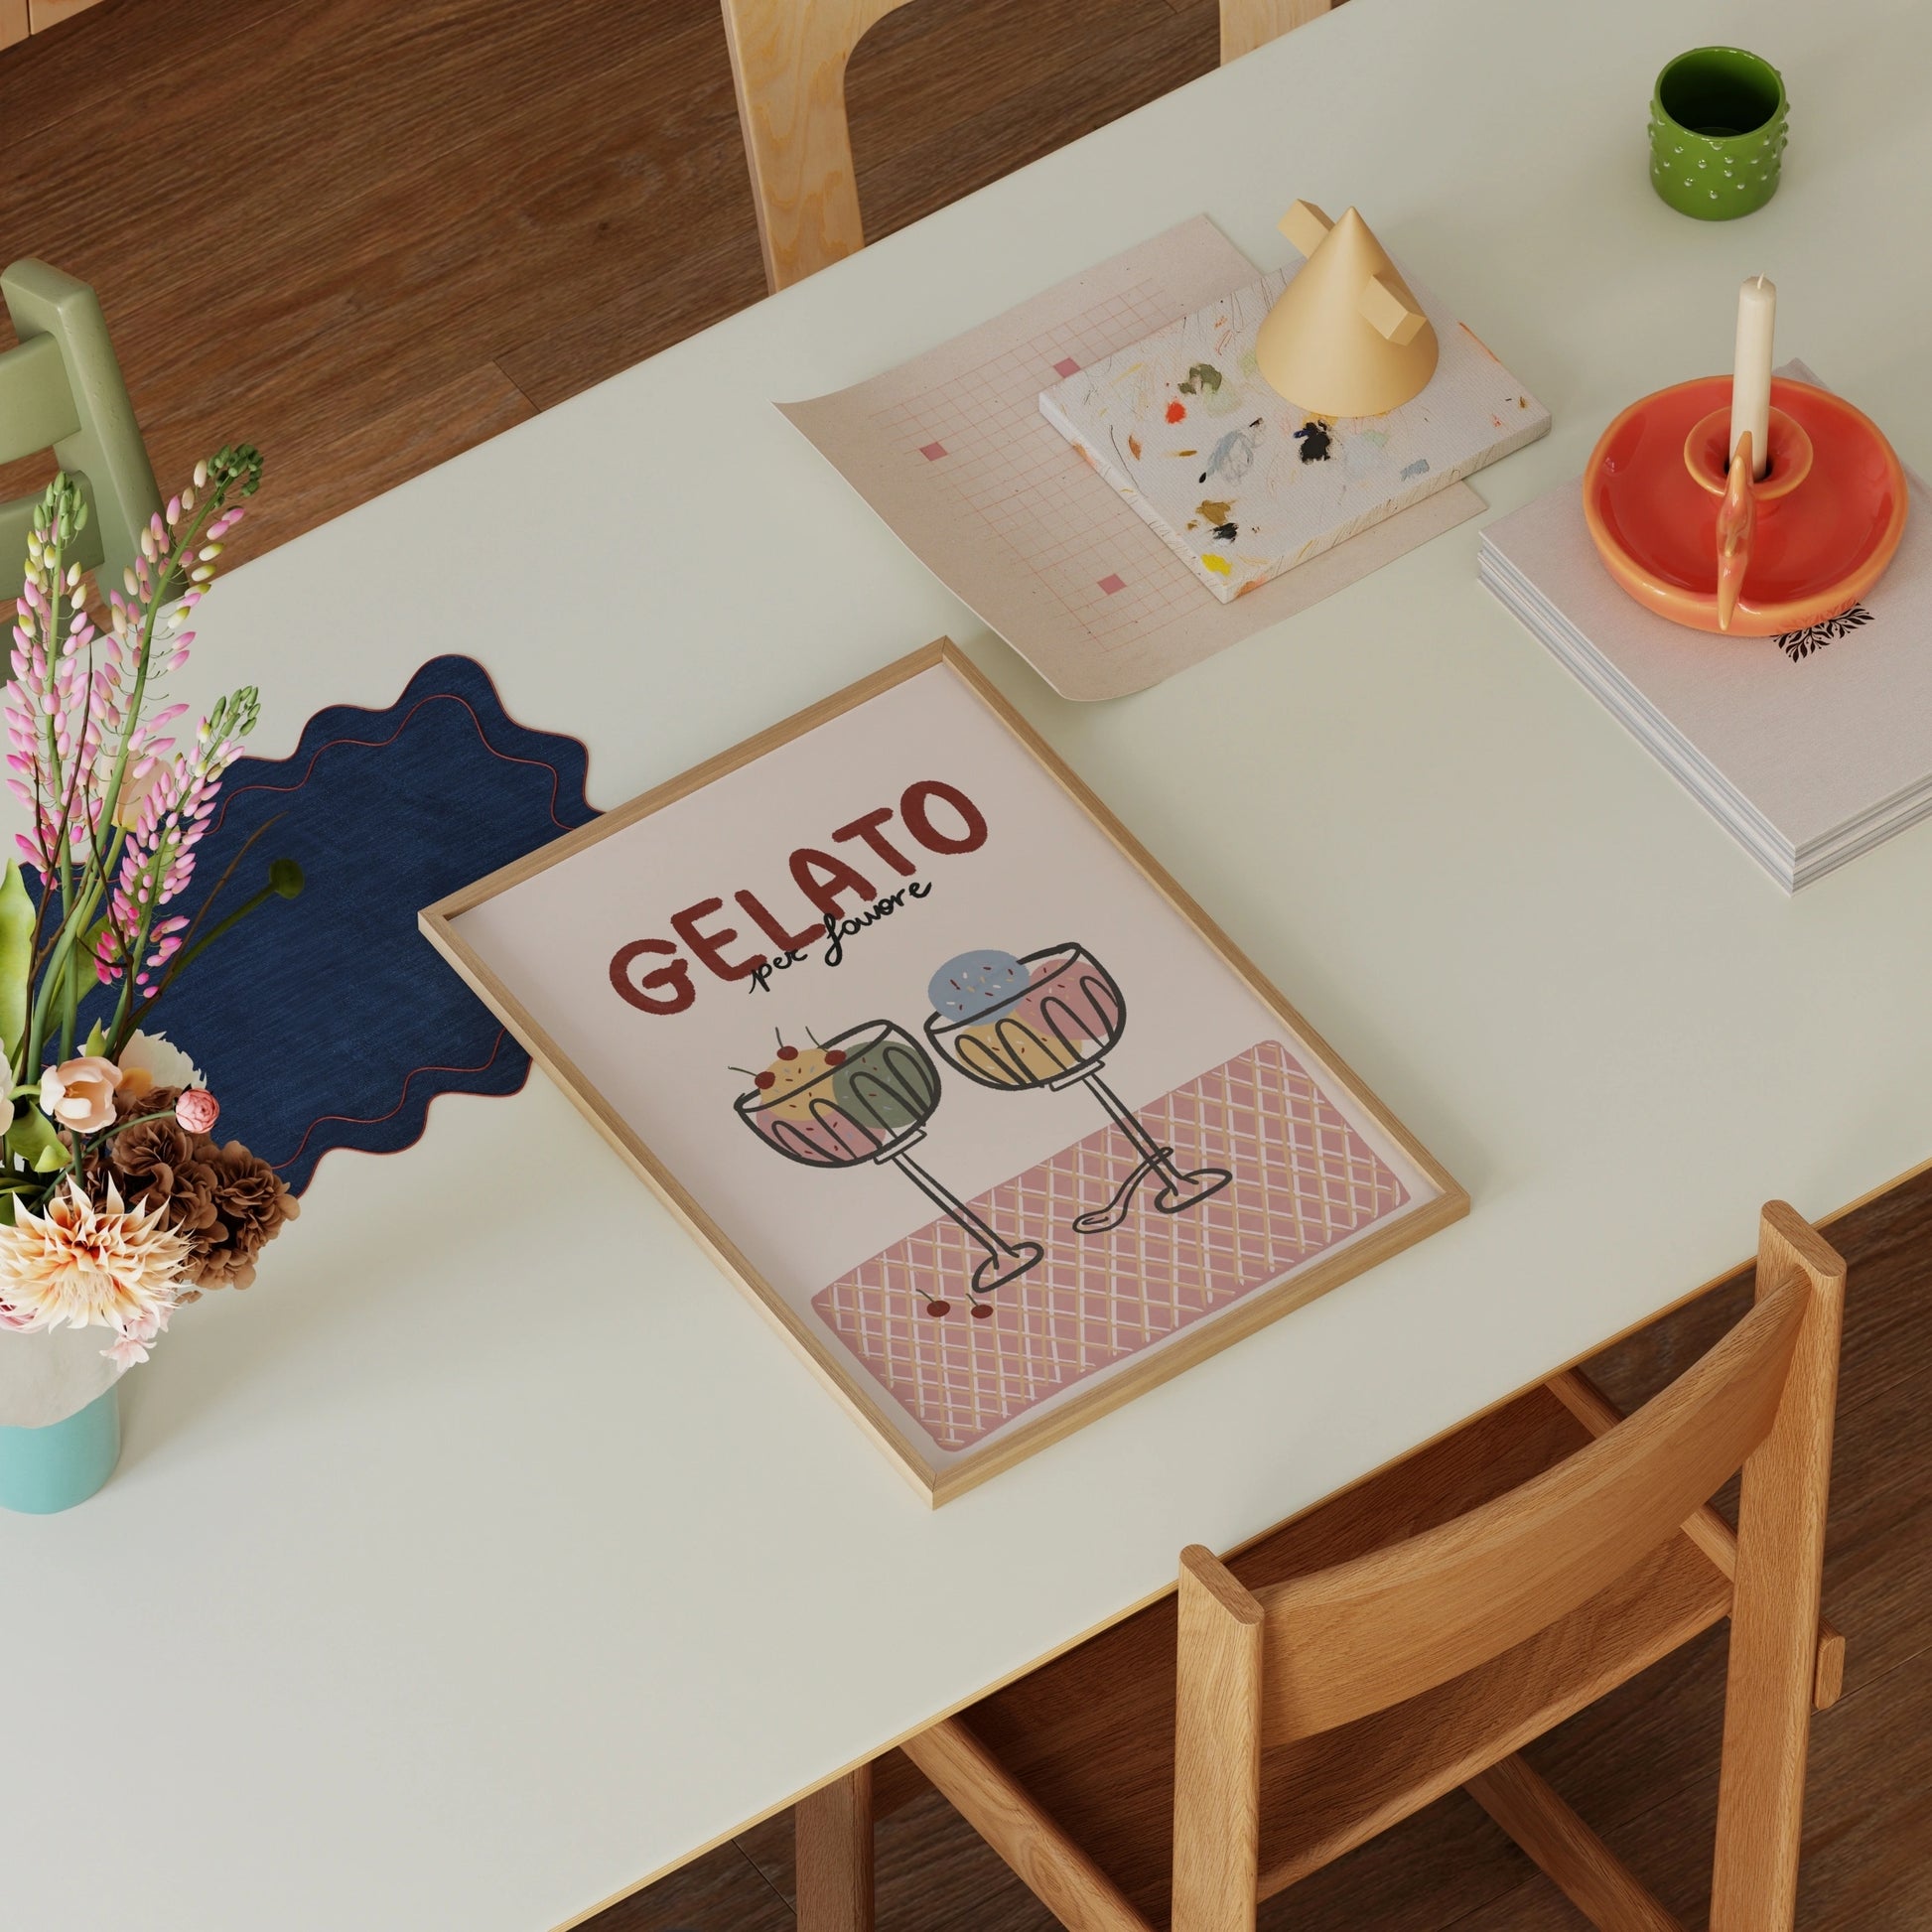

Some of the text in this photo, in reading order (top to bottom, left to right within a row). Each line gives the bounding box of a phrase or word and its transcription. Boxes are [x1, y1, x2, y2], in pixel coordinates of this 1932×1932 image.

[609, 780, 988, 1015] GELATO
[749, 882, 932, 994] per favore
